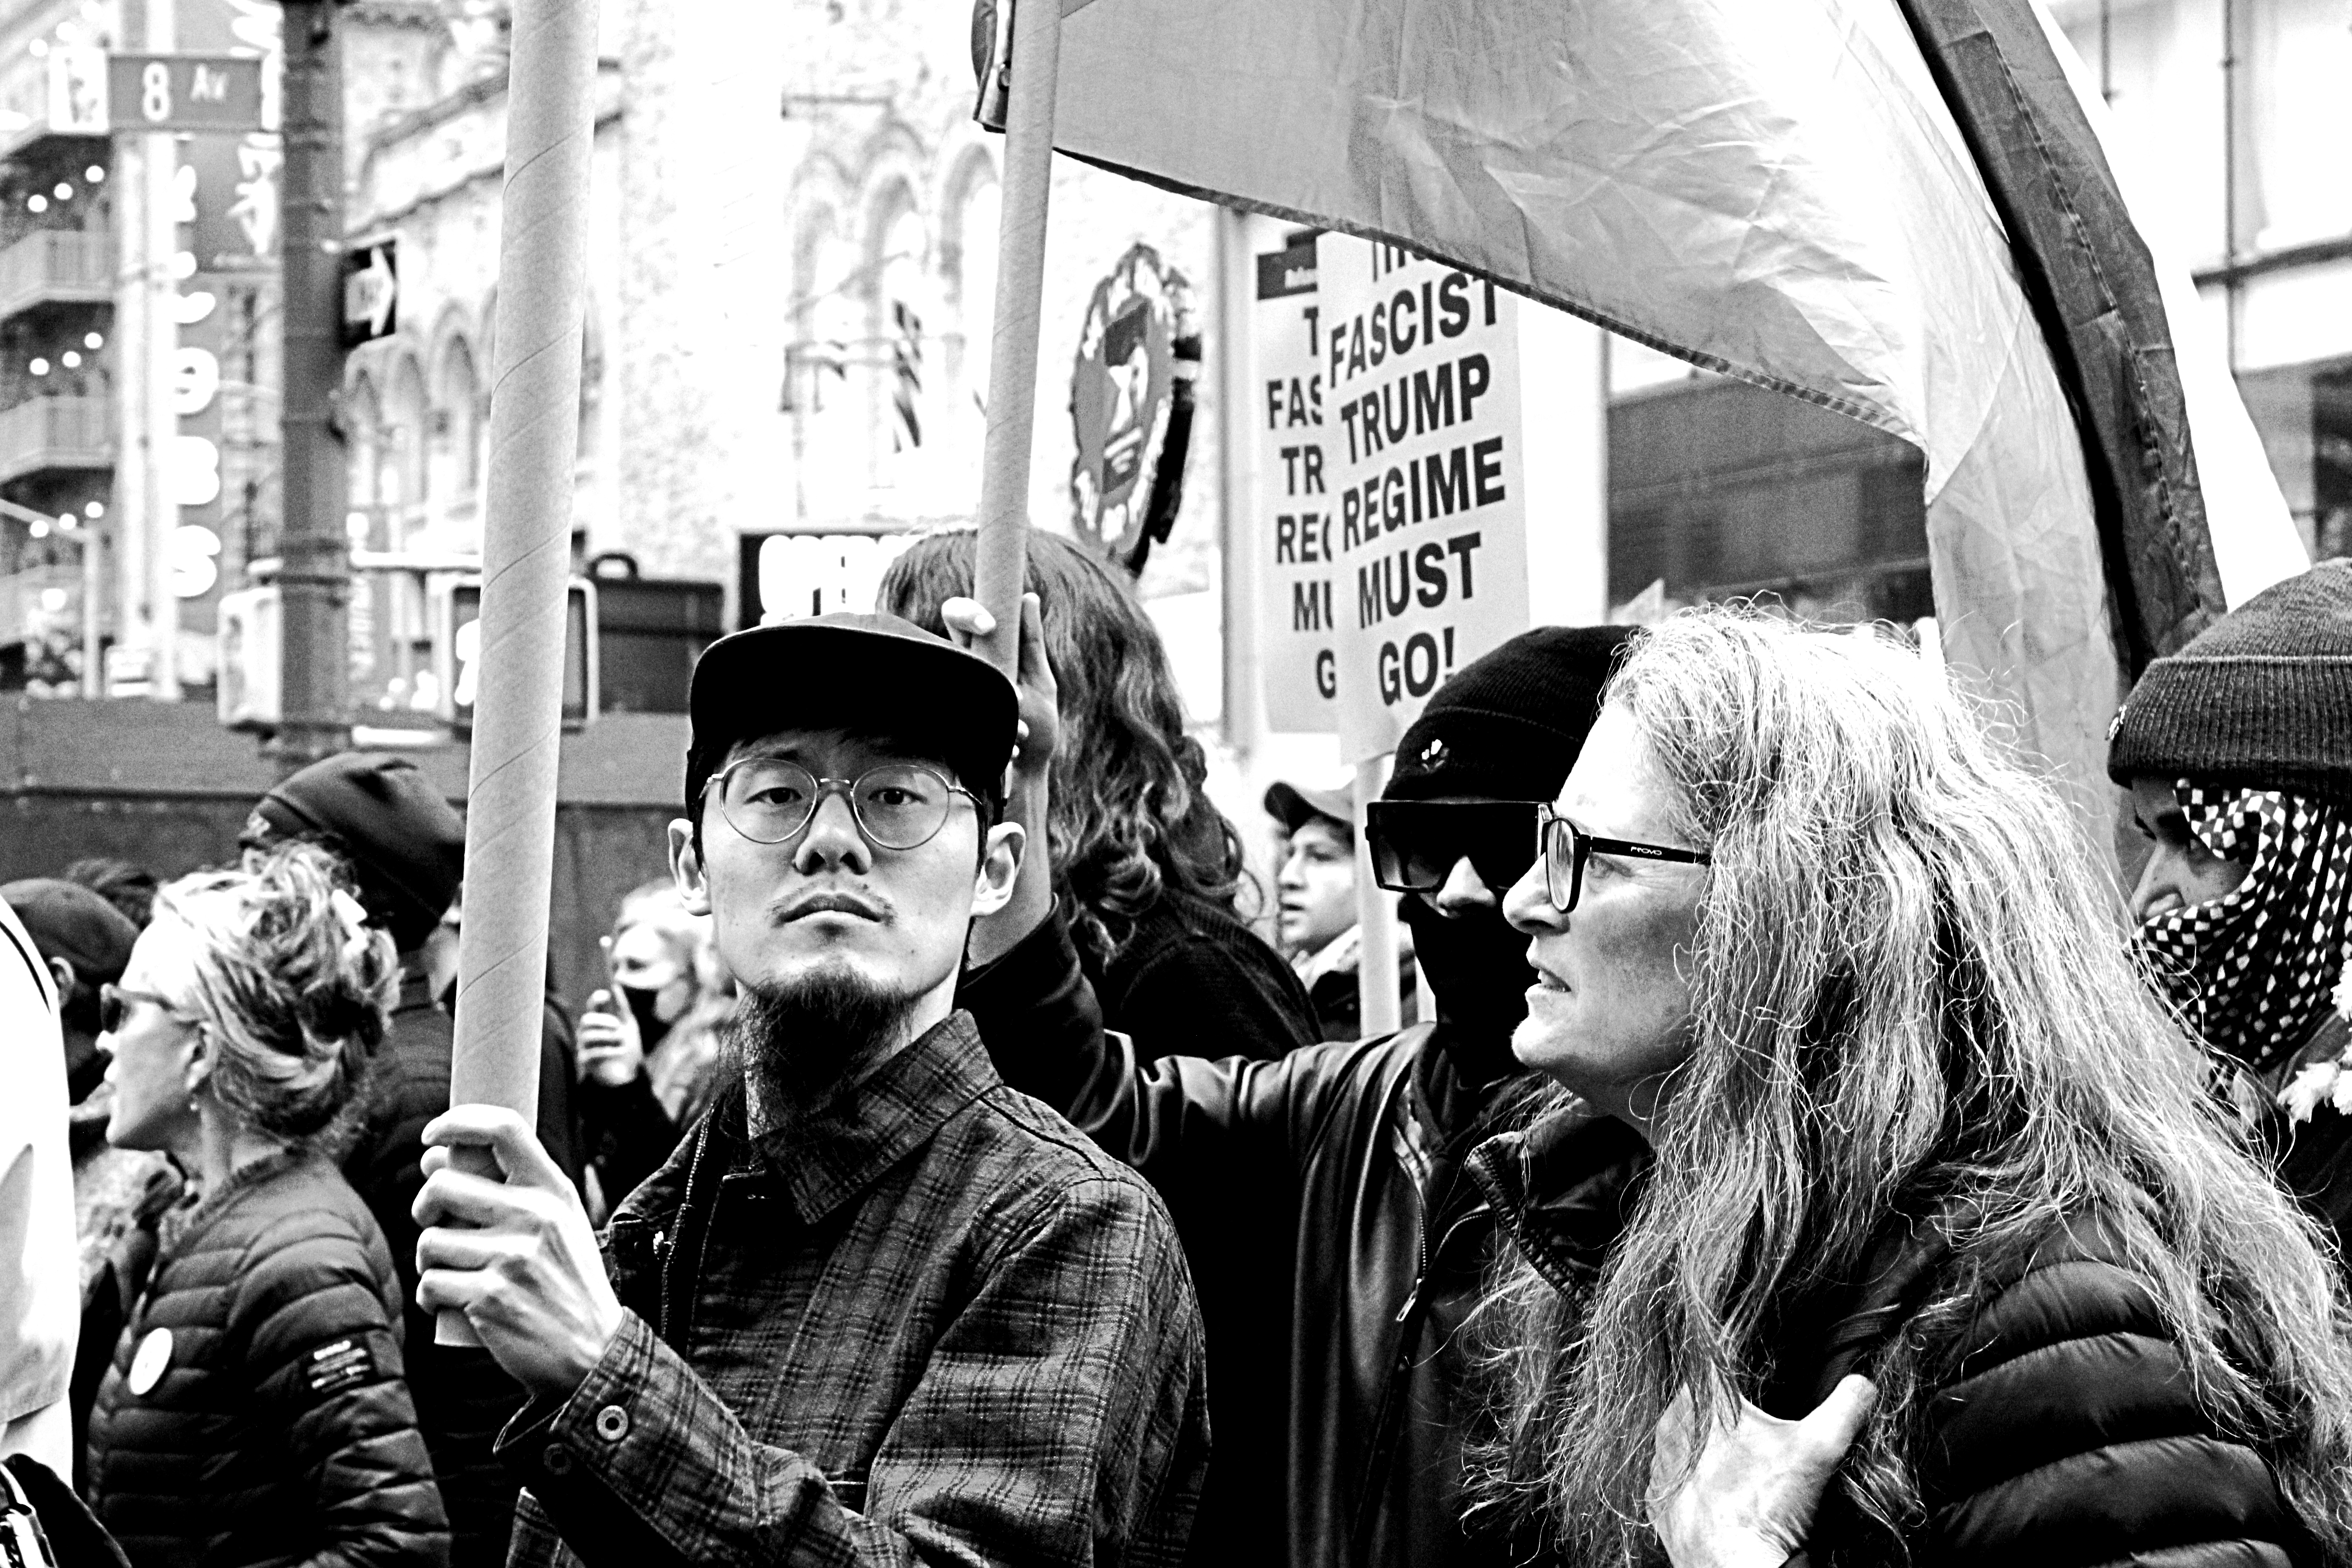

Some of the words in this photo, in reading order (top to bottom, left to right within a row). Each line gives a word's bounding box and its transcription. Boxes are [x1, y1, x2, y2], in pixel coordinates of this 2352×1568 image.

[143, 63, 171, 121] 8
[1330, 271, 1496, 388] FASCIST
[1341, 353, 1490, 464] TRUMP
[1343, 436, 1505, 552] REGIME
[1358, 531, 1481, 629] MUST
[1378, 626, 1454, 706] GO!
